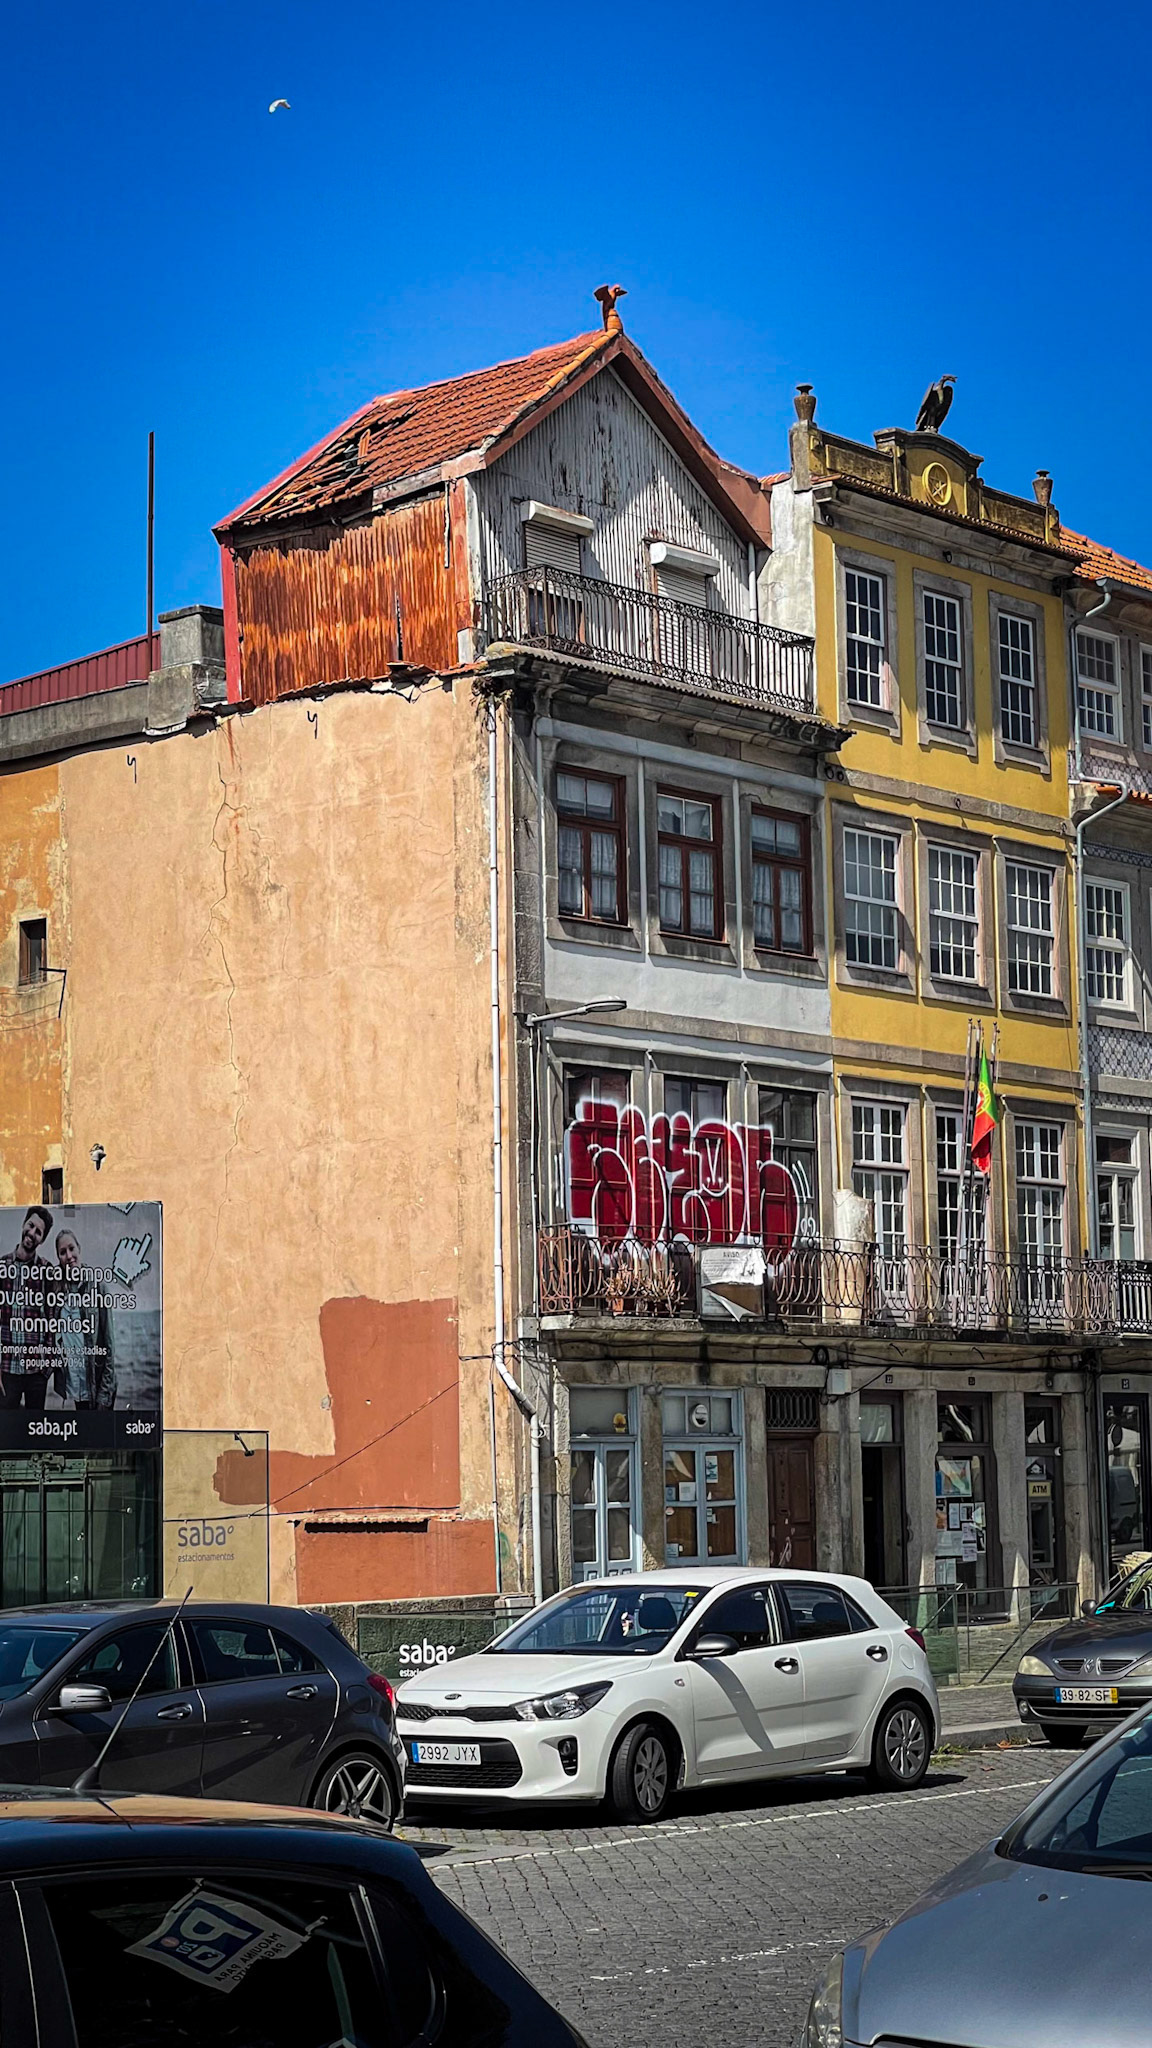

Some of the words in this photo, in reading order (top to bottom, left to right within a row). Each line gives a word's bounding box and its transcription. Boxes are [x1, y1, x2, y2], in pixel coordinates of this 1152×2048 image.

[0, 1260, 17, 1279] ão
[20, 1264, 63, 1286] perca
[66, 1263, 117, 1288] tempo.
[0, 1286, 43, 1307] oveite
[47, 1292, 65, 1307] os
[68, 1288, 137, 1309] melhores
[9, 1314, 95, 1334] momentos!
[28, 1343, 51, 1354] online
[76, 1345, 107, 1356] estadias
[20, 1359, 25, 1367] e
[26, 1359, 50, 1370] poupe
[28, 1417, 78, 1441] saba.pt
[1032, 1485, 1048, 1494] ATM
[178, 1553, 235, 1563] estacionamentos
[419, 1746, 450, 1761] 2992
[454, 1746, 478, 1762] JYX
